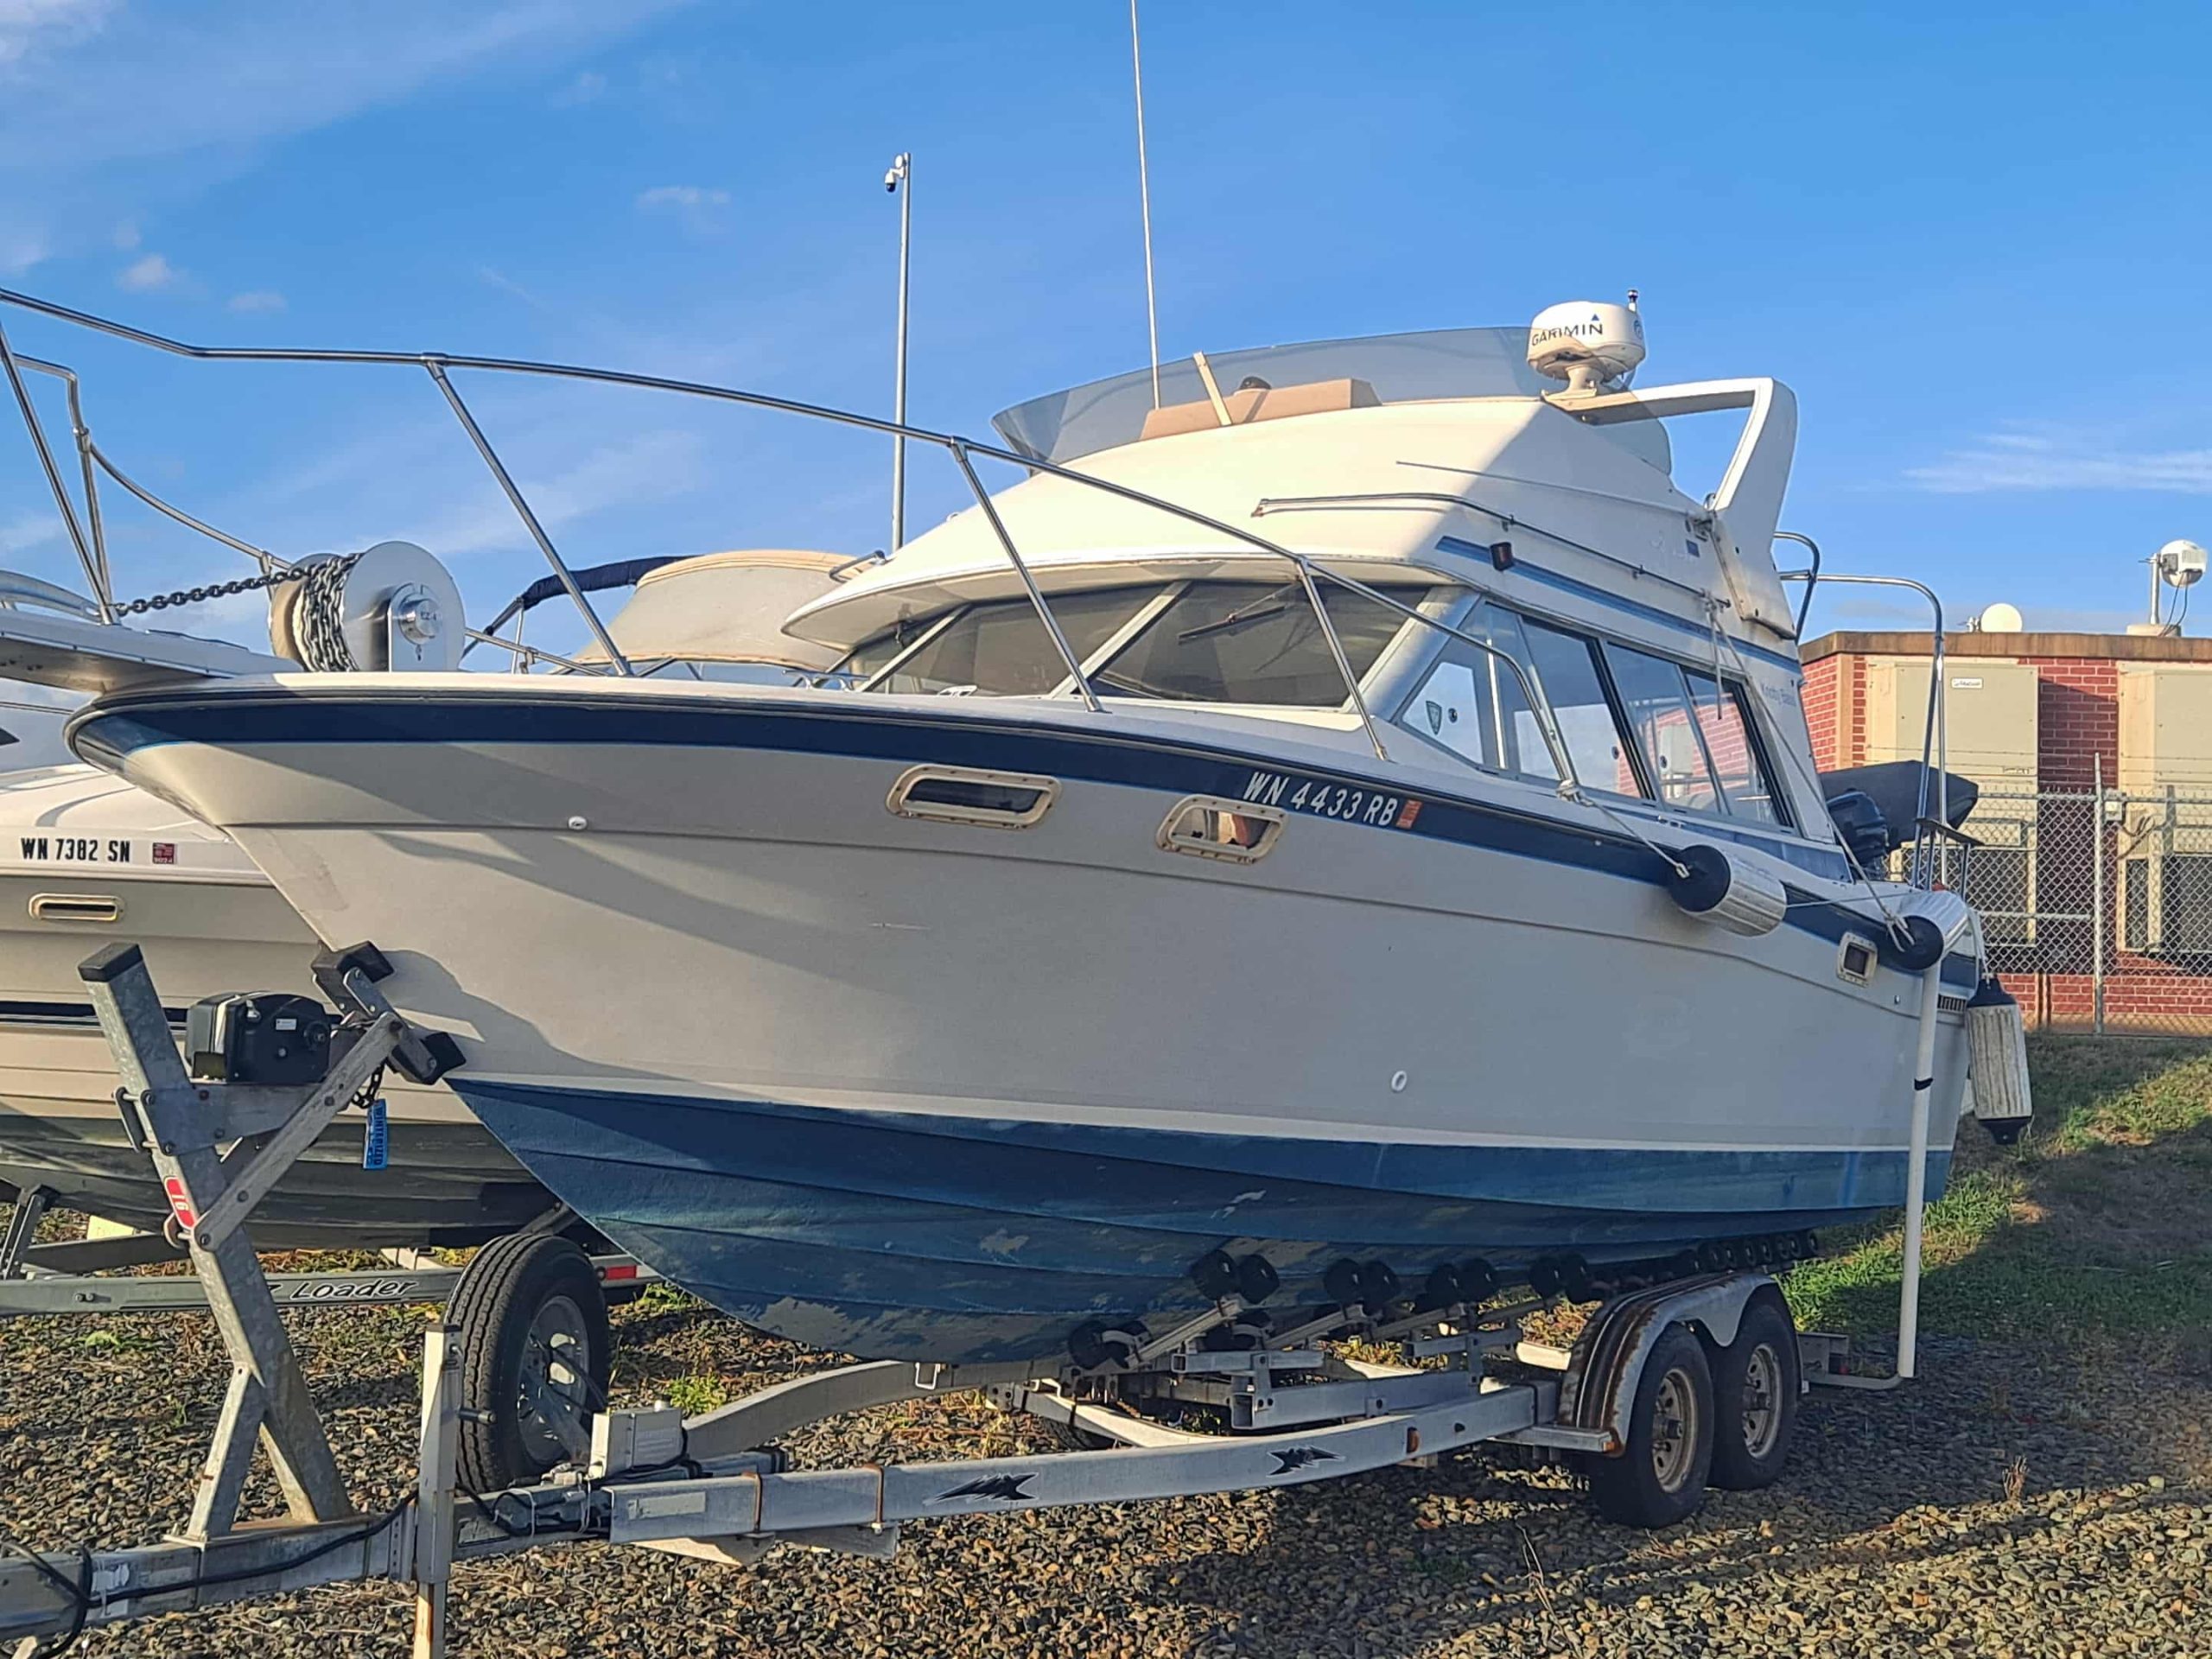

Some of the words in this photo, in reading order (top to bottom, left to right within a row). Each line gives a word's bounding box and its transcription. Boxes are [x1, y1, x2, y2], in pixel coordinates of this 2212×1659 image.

[1531, 323, 1604, 346] GARMIN
[1243, 771, 1289, 805] WN
[1290, 782, 1363, 820] 4433
[1363, 794, 1398, 826] RB
[21, 838, 48, 860] WN
[55, 838, 99, 861] 7382
[107, 841, 130, 862] SN
[372, 1105, 384, 1166] WINTERIZED
[289, 1278, 420, 1300] Loader
